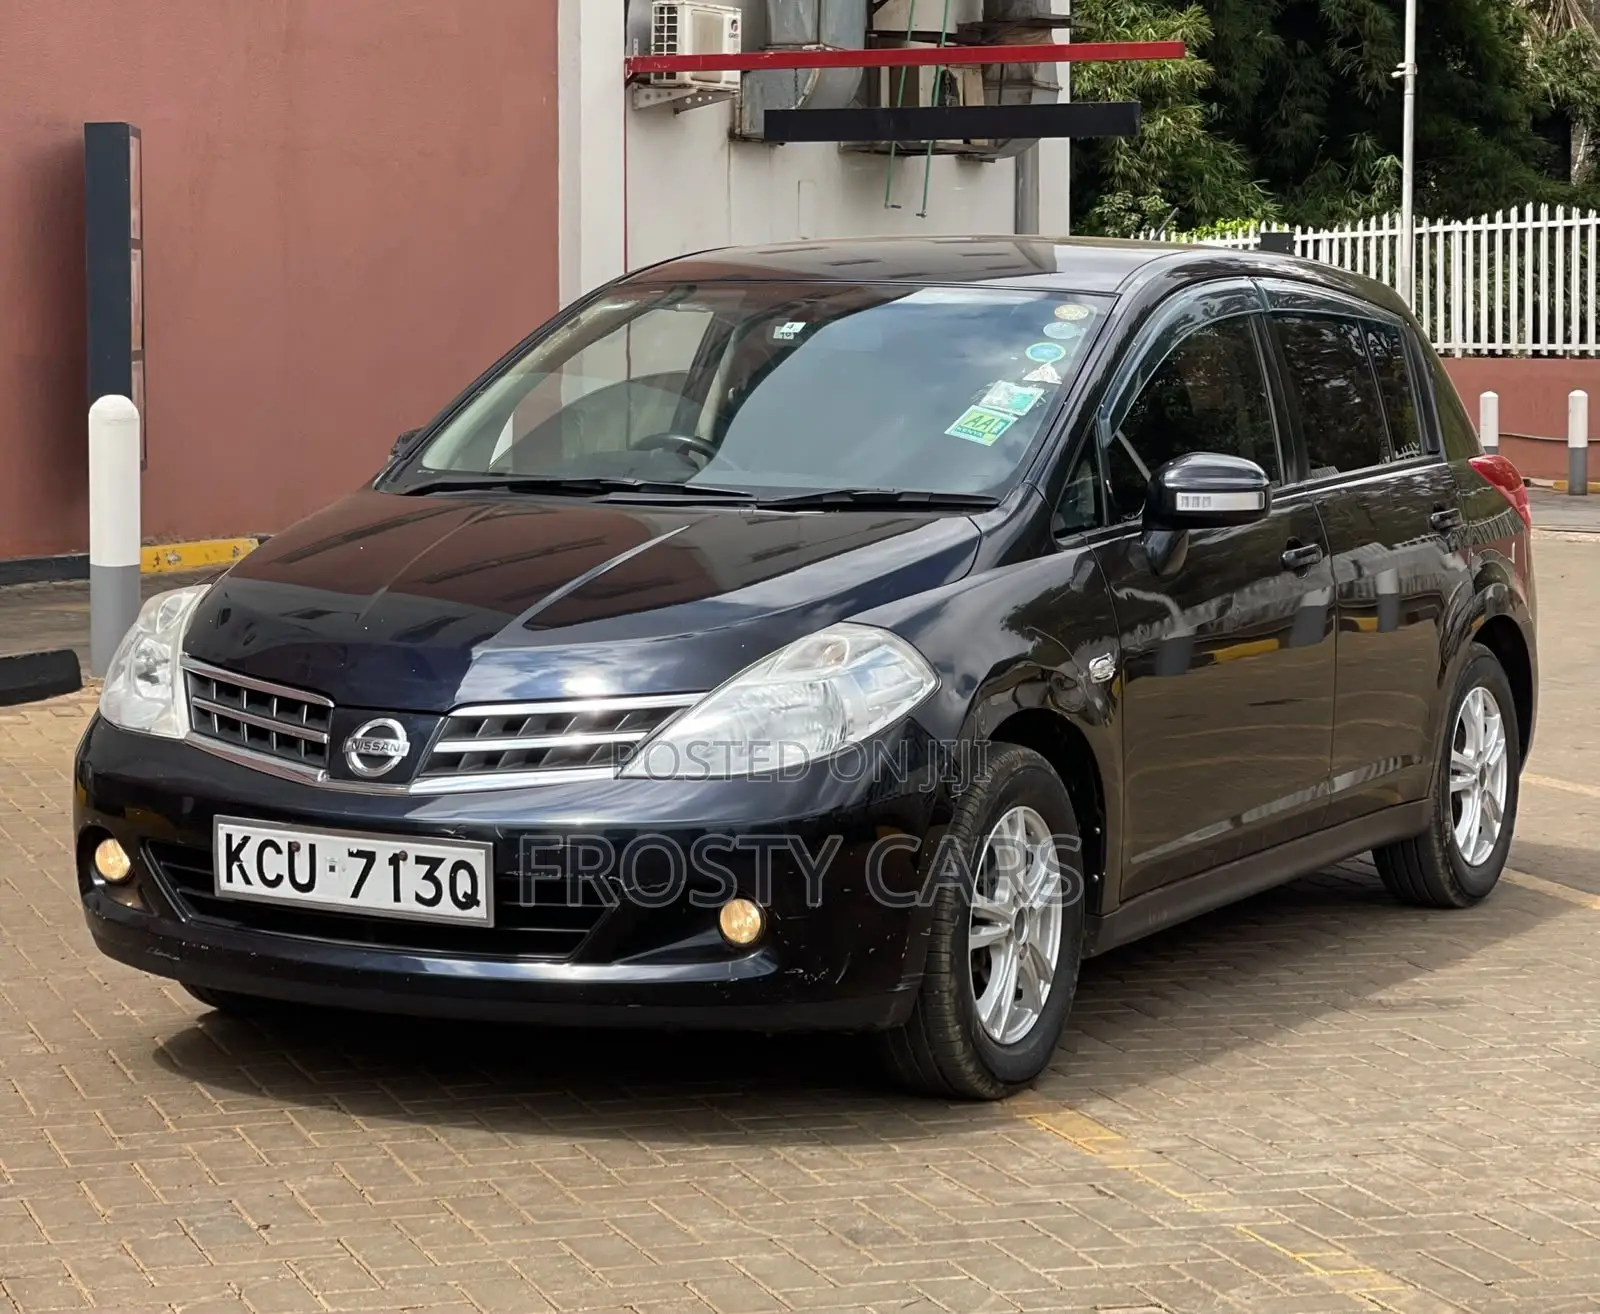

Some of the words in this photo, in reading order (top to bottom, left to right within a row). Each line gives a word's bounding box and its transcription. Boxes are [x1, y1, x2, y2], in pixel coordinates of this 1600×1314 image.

[351, 740, 401, 753] NISSAN
[225, 832, 317, 894] KCU
[347, 847, 480, 911] 713Q
